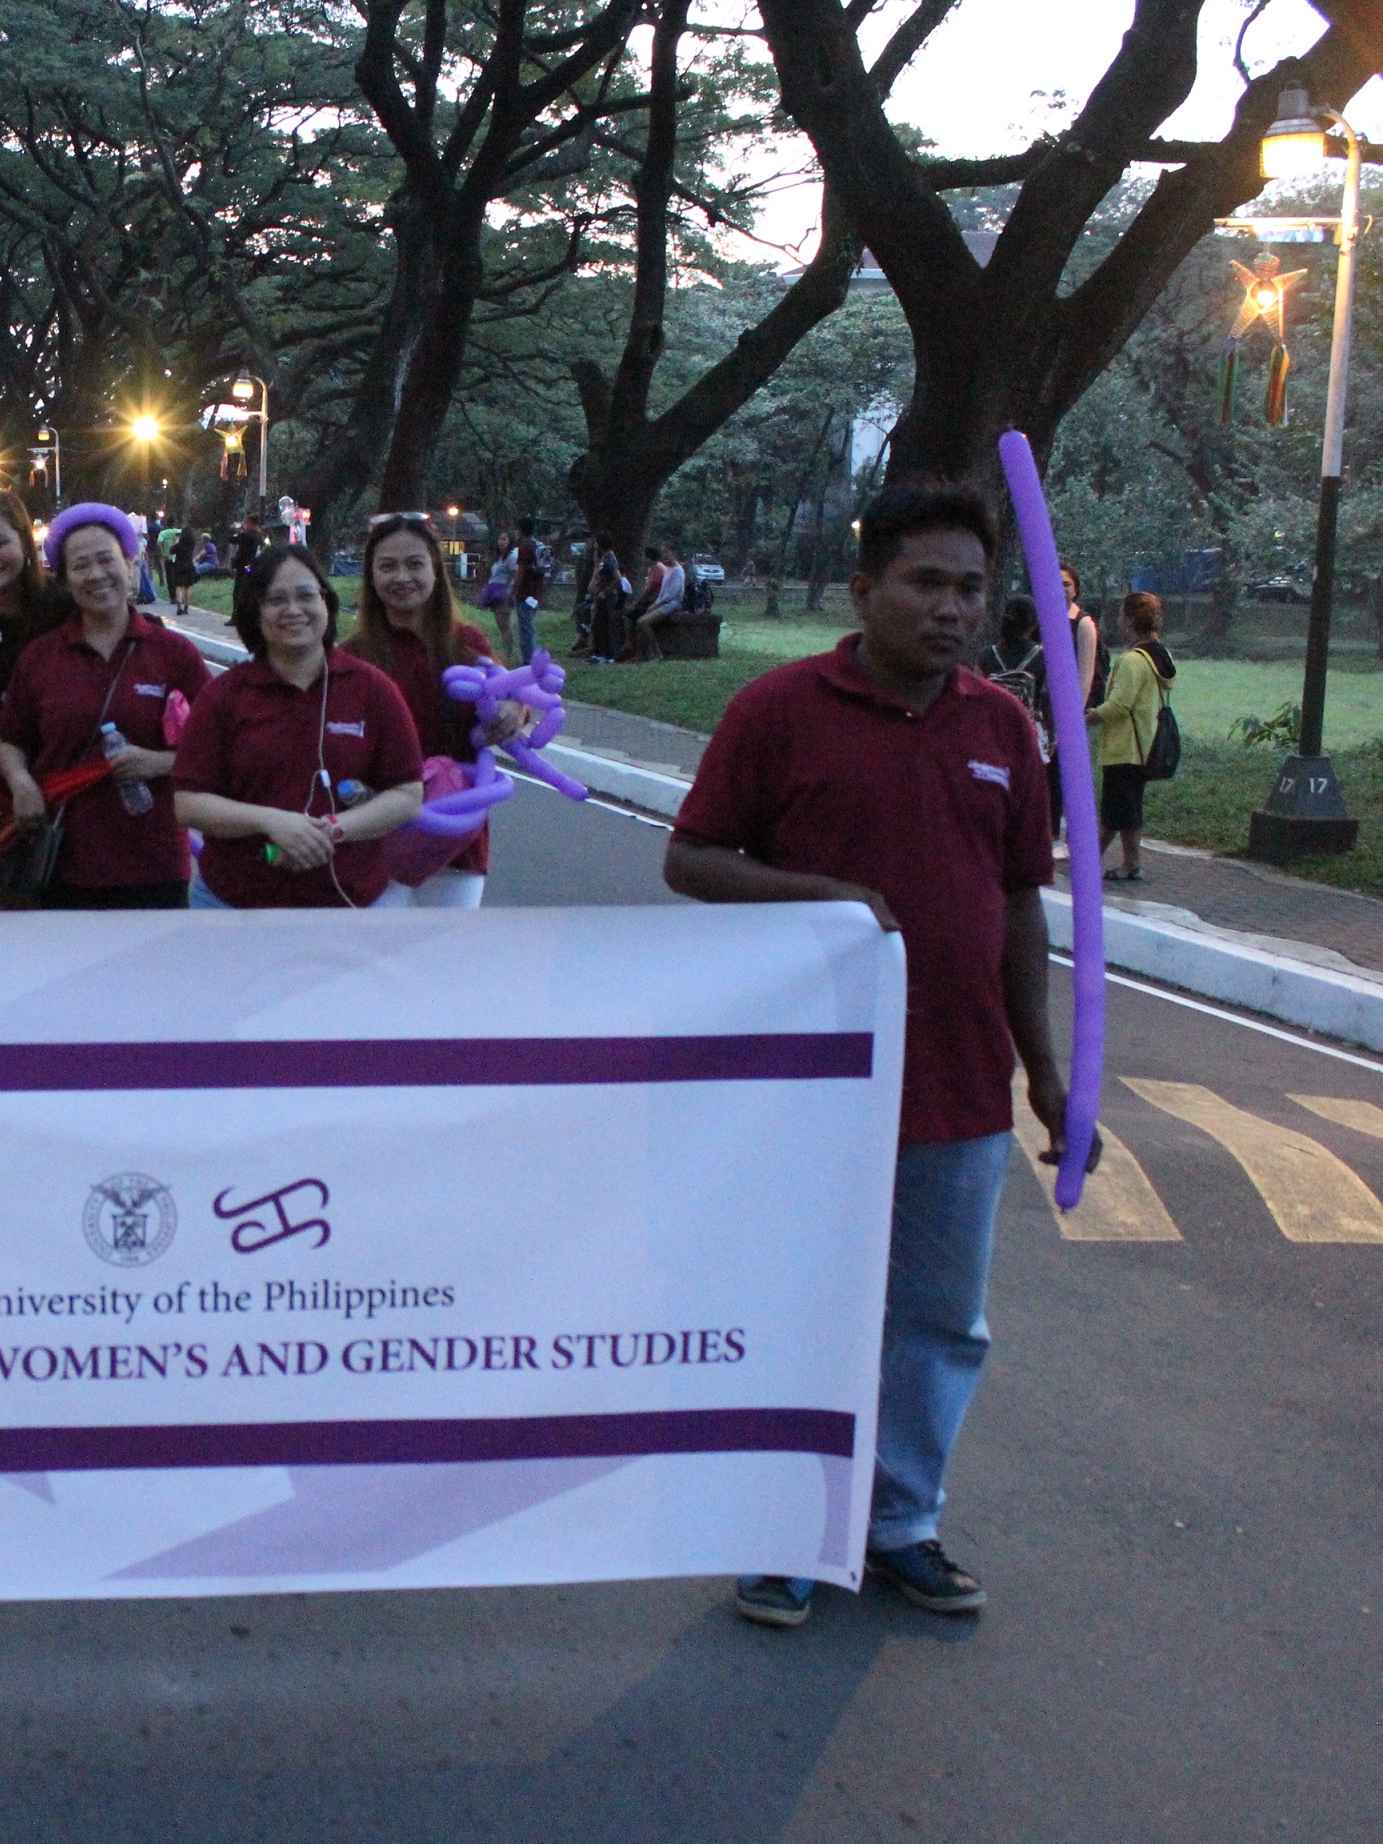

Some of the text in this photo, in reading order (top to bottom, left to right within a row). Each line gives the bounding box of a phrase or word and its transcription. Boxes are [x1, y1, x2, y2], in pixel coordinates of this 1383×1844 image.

[1279, 777, 1295, 793] 17
[1309, 778, 1328, 793] 17
[153, 1281, 193, 1315] of
[198, 1281, 252, 1314] the
[264, 1279, 456, 1320] Philippines
[222, 1340, 329, 1378] AND
[341, 1334, 542, 1375] GENDER
[551, 1327, 746, 1371] STUDIES
